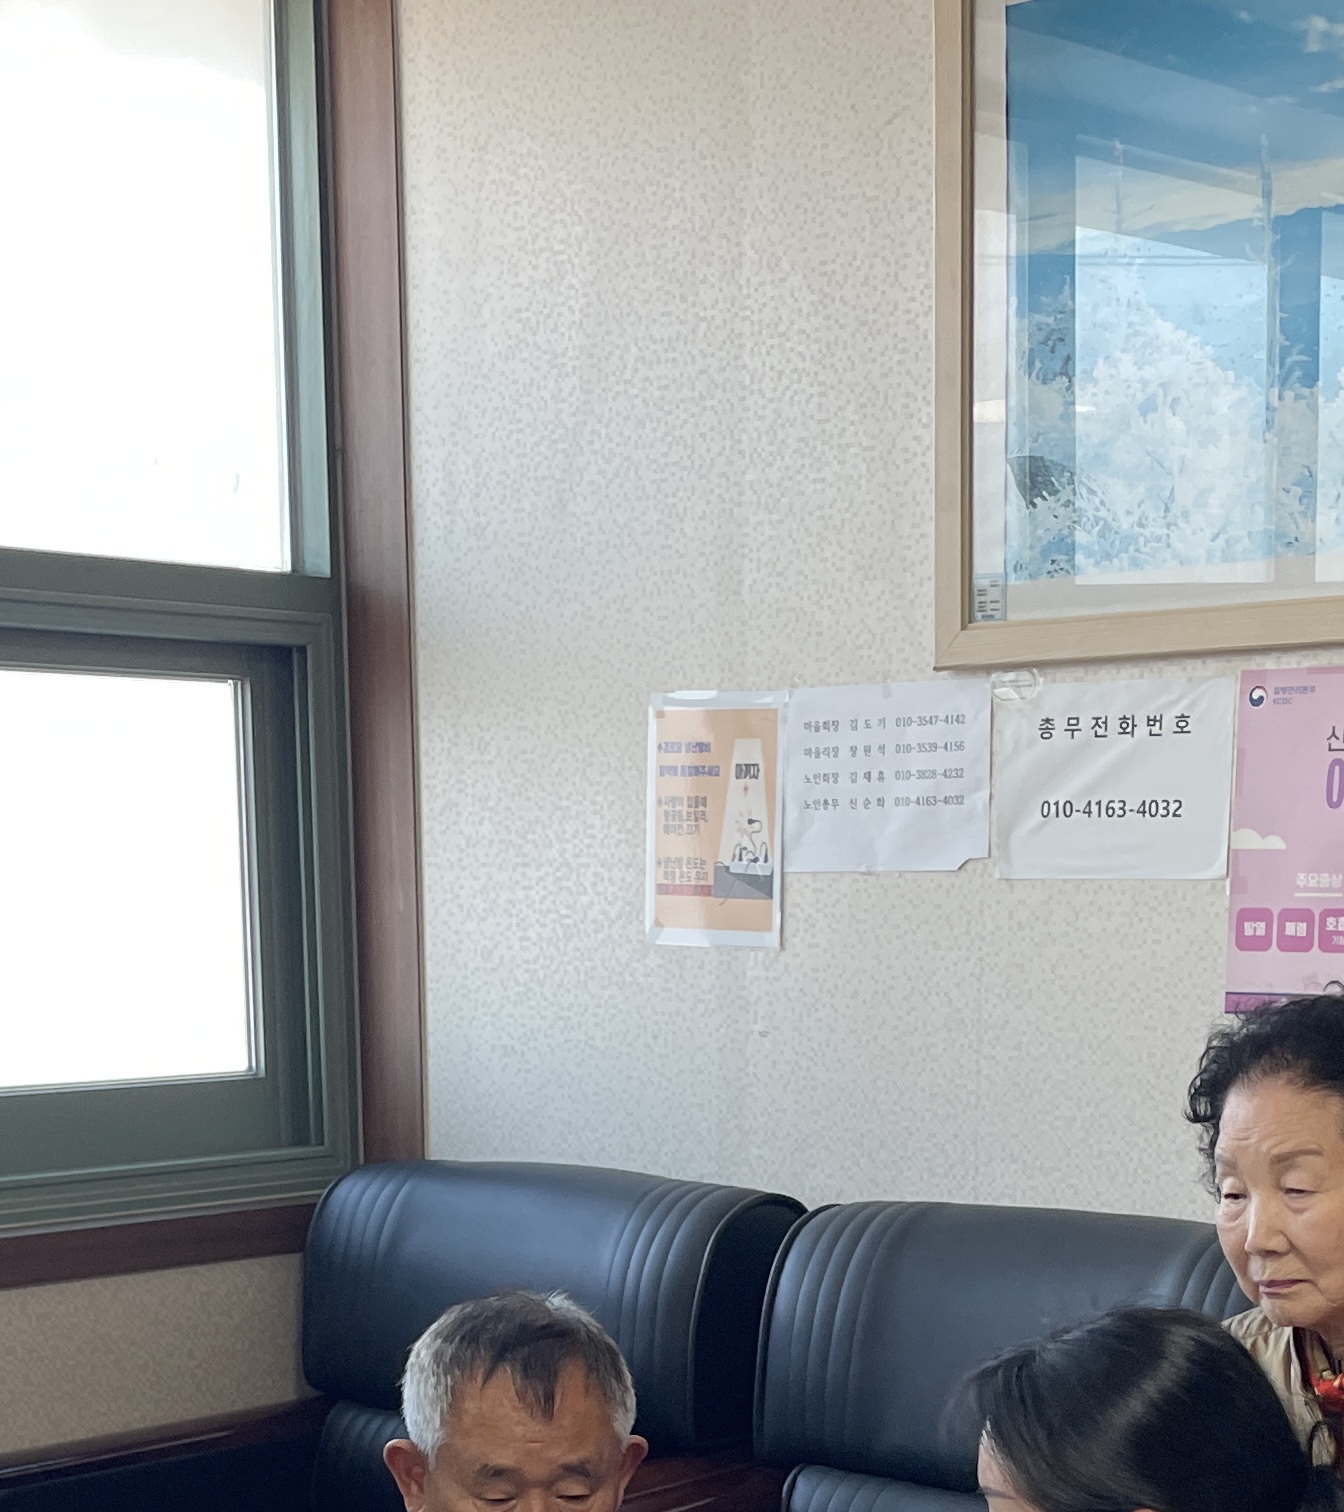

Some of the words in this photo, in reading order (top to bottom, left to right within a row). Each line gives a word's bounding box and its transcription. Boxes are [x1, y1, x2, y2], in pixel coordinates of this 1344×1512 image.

[895, 714, 966, 728] 010-3547-4142
[894, 795, 965, 808] 010-4163-4032
[1041, 800, 1183, 818] 010-4163-4032
[1296, 872, 1343, 888] 주요증상
